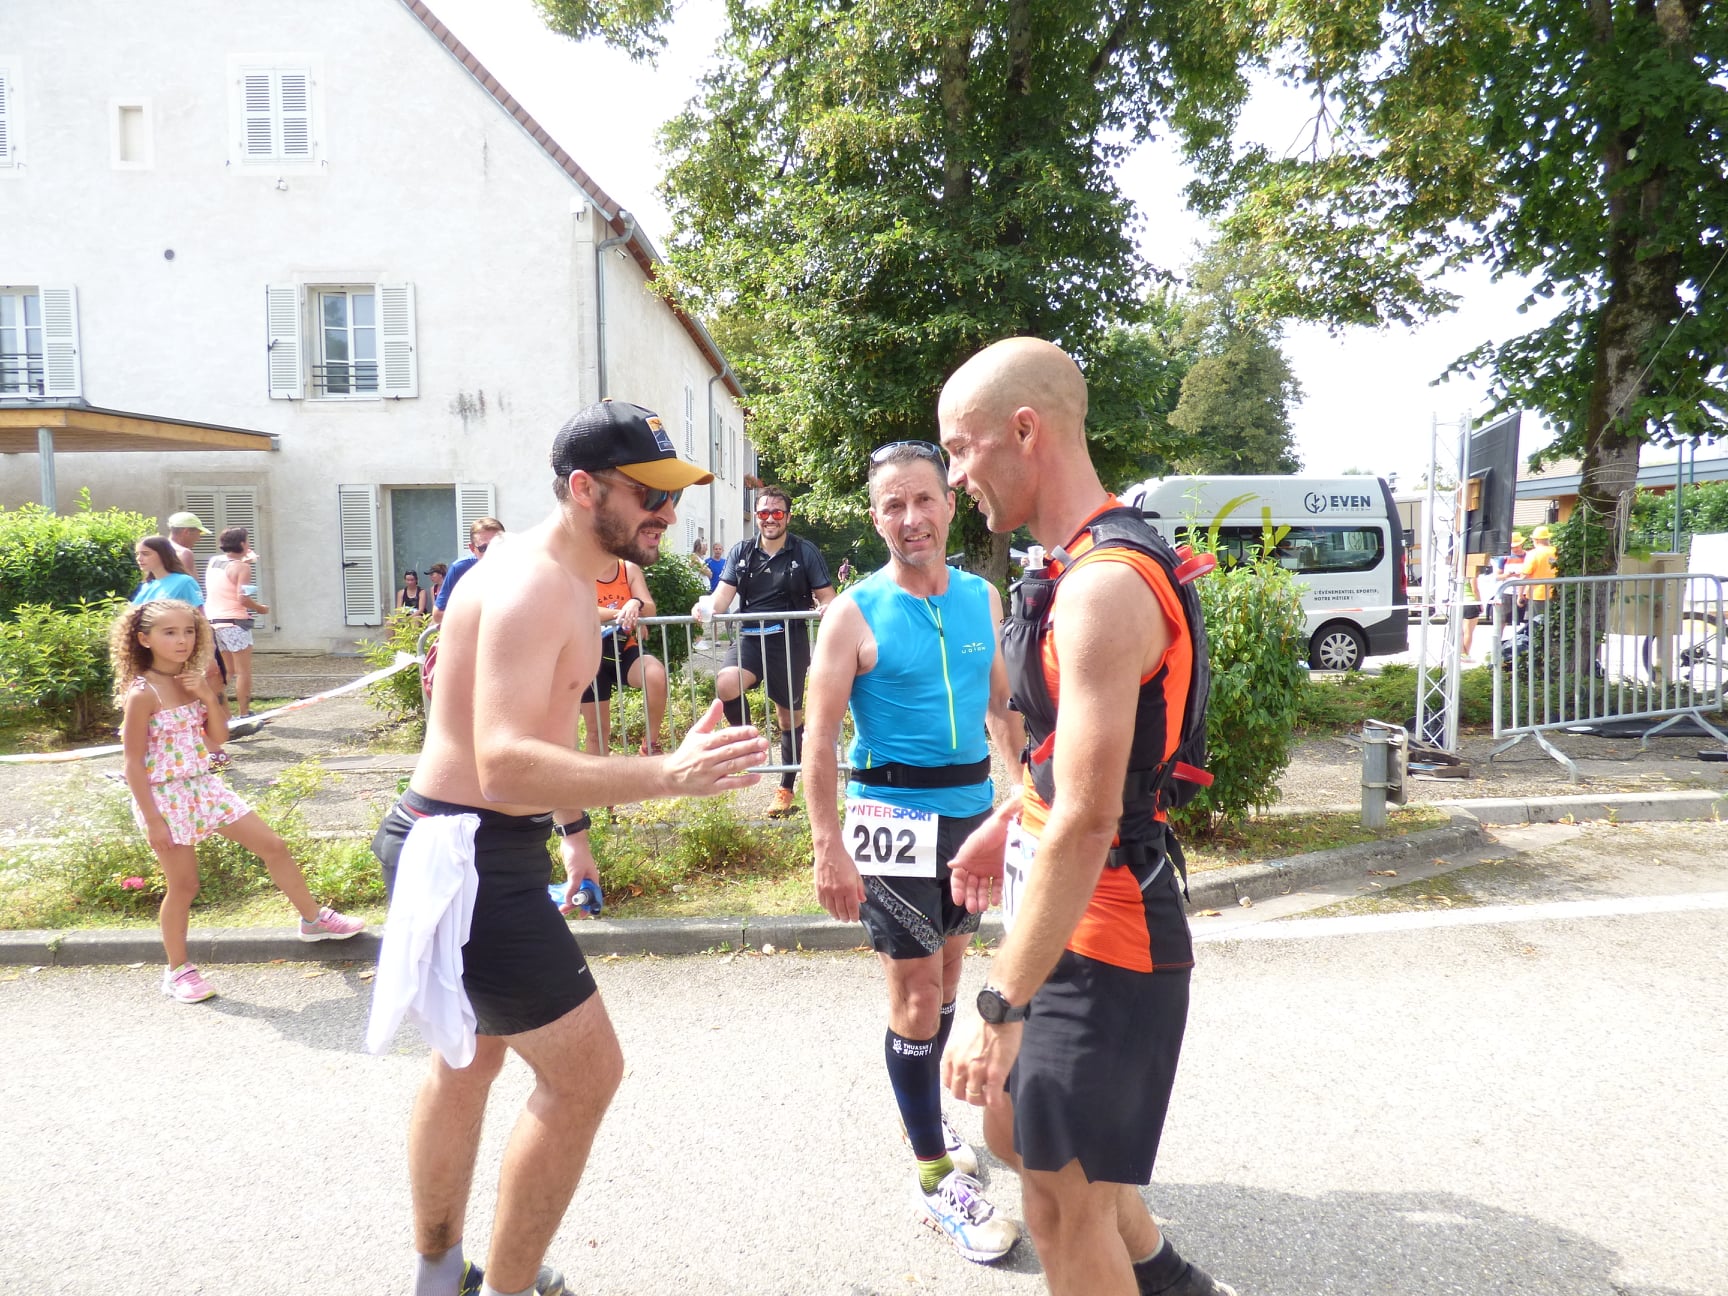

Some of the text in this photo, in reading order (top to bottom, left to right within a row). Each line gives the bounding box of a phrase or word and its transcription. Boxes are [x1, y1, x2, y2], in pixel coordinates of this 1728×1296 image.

[1330, 495, 1371, 507] EVEN
[853, 824, 917, 865] 202
[902, 1048, 929, 1057] SPORT
